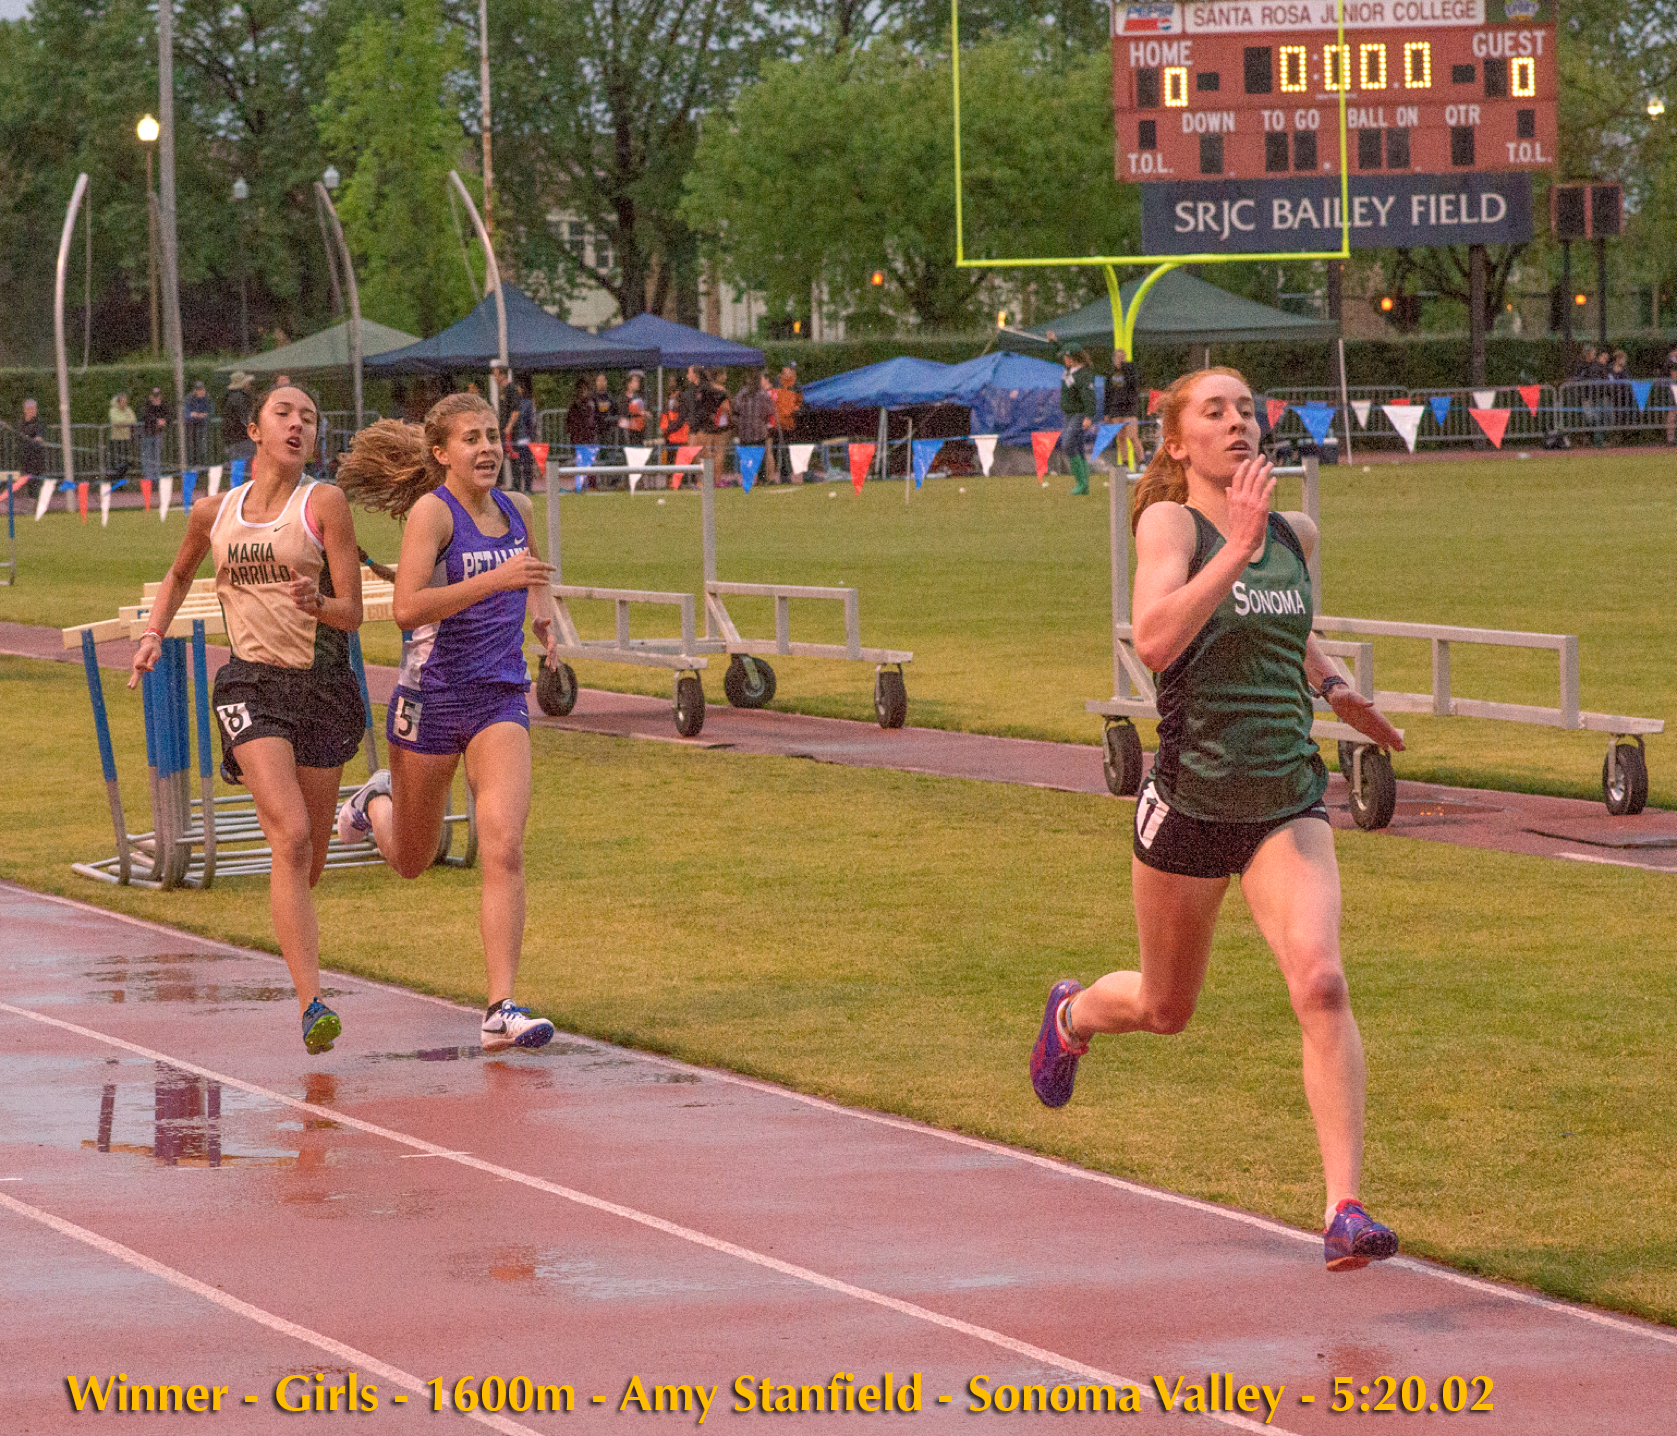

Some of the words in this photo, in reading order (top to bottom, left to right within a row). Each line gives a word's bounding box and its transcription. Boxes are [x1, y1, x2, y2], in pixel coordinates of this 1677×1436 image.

[1194, 6, 1251, 27] SANTA
[1261, 4, 1312, 25] ROSA
[1321, 3, 1385, 24] JUNIOR
[1393, 0, 1477, 22] COLLEGE
[1129, 40, 1194, 67] HOME
[1472, 29, 1546, 58] GUEST
[1164, 66, 1188, 107] 0
[1512, 57, 1535, 97] 0
[1181, 111, 1236, 134] DOWN
[1262, 109, 1286, 131] TO
[1294, 108, 1321, 130] GO
[1347, 106, 1388, 129] BALL
[1396, 105, 1419, 127] ON
[1174, 199, 1257, 241] SRJC
[1272, 194, 1396, 231] BAILEY
[1411, 192, 1508, 226] FIELD
[227, 542, 276, 564] MARIA
[222, 705, 244, 733] 8
[398, 699, 416, 737] 5
